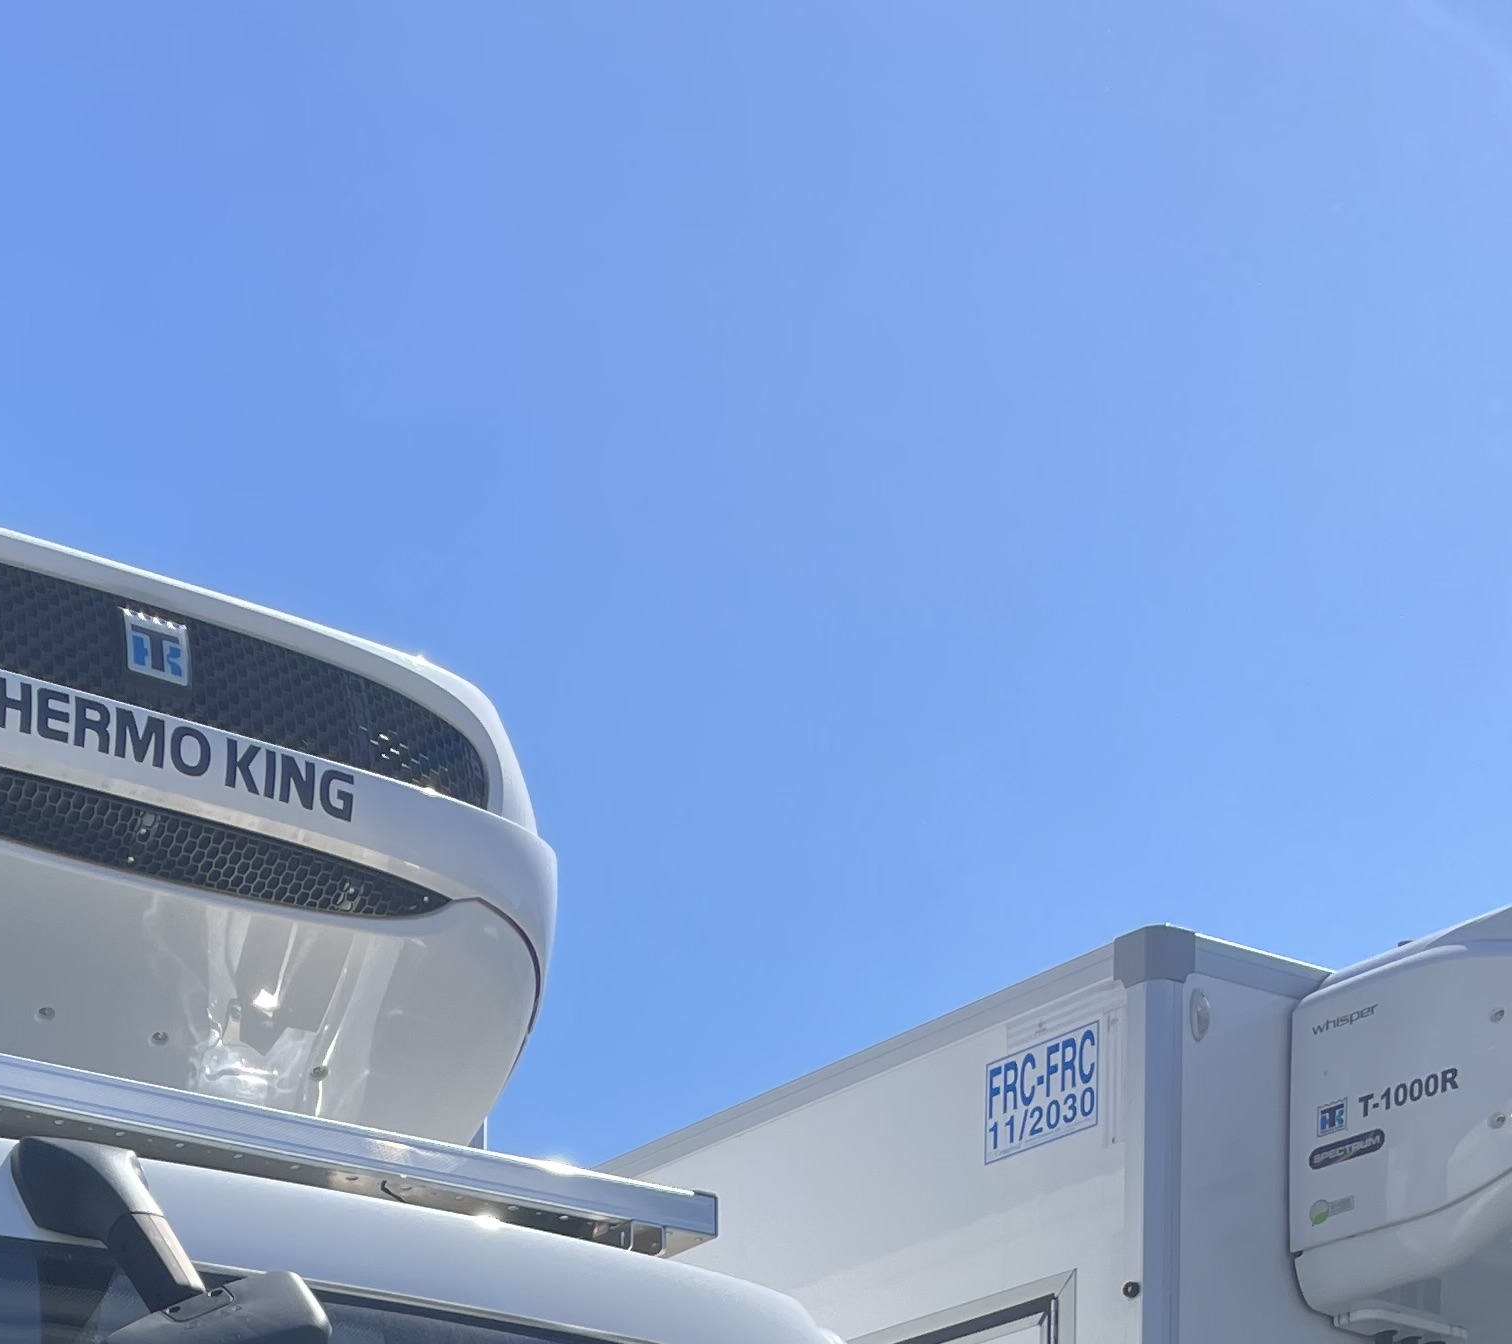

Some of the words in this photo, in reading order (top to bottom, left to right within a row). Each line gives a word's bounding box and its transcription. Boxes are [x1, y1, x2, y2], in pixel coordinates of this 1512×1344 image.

[225, 737, 355, 823] KING
[1311, 1003, 1379, 1036] whisper
[988, 1029, 1096, 1119] FRC-FRC
[1358, 1067, 1459, 1118] T-1000R
[988, 1086, 1095, 1150] 11/2030
[1312, 1134, 1382, 1165] SPECTRUM
